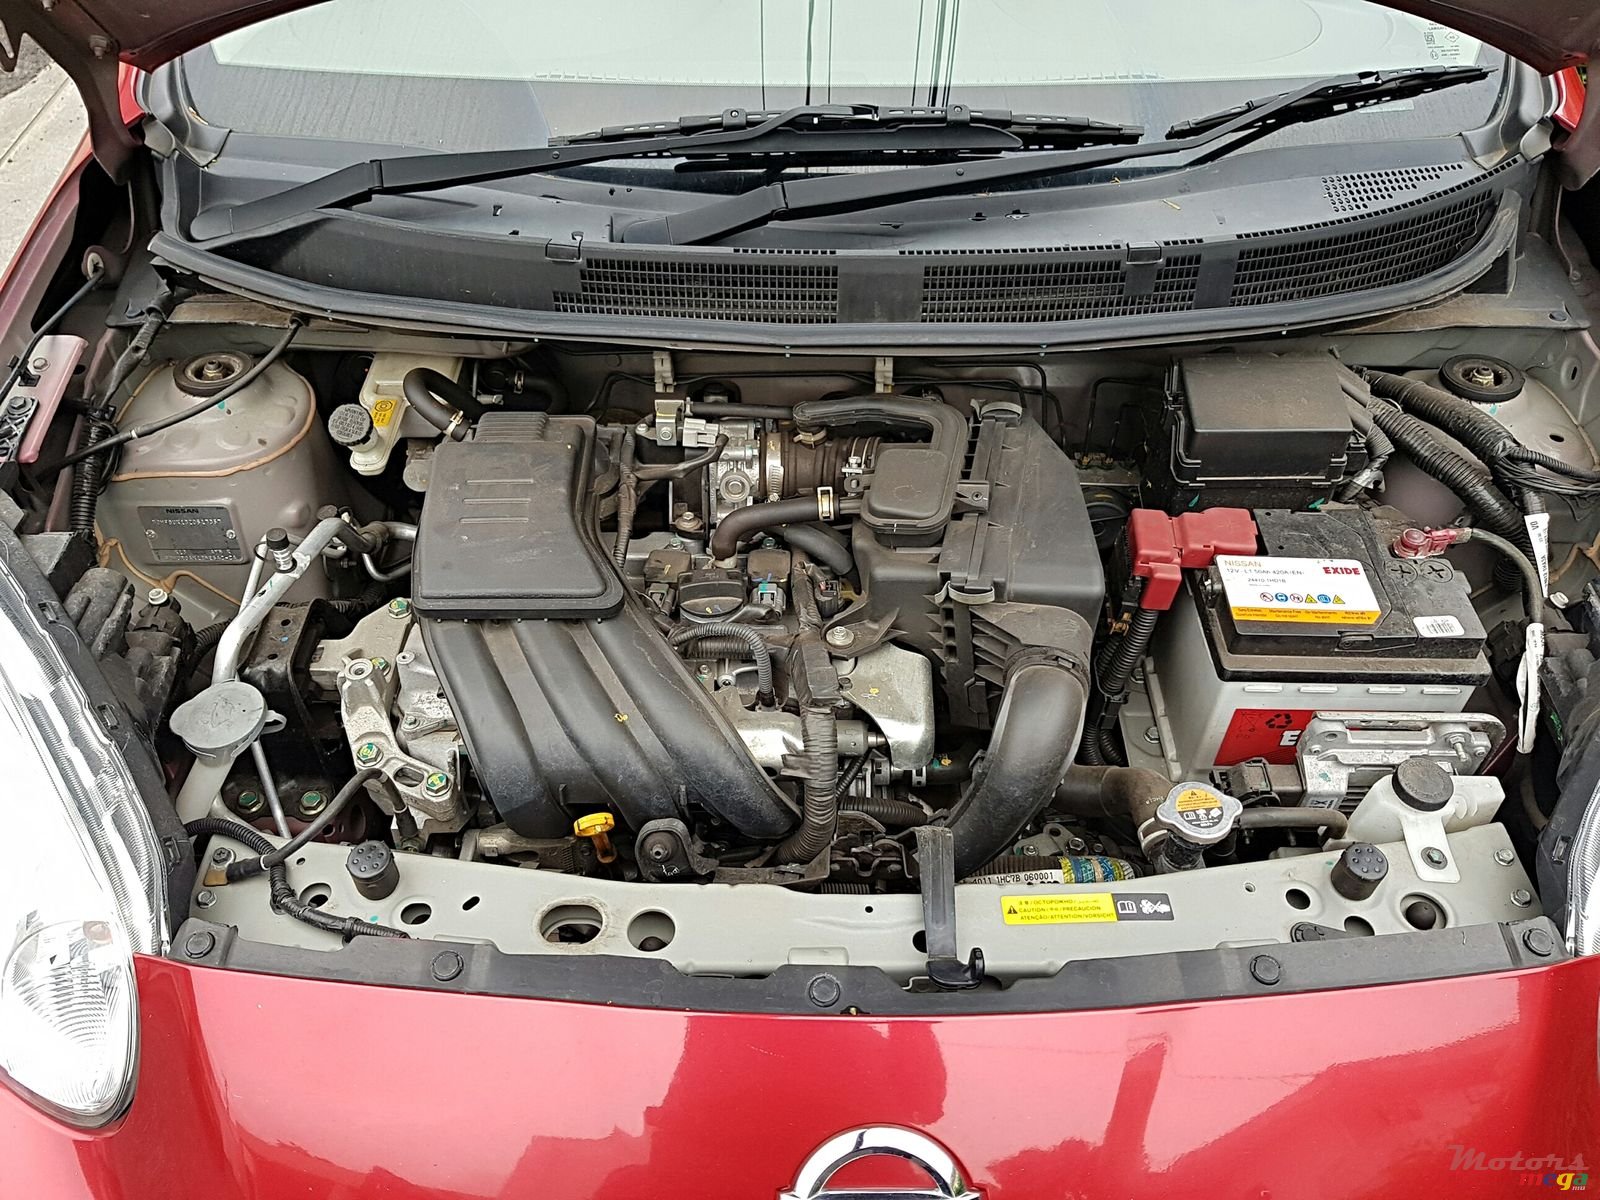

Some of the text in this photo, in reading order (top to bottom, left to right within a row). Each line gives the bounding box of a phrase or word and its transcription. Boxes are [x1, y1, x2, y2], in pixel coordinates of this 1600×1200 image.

[1323, 566, 1361, 575] EXIDE
[996, 873, 1021, 884] 1HC7B
[1024, 871, 1054, 882] 060001
